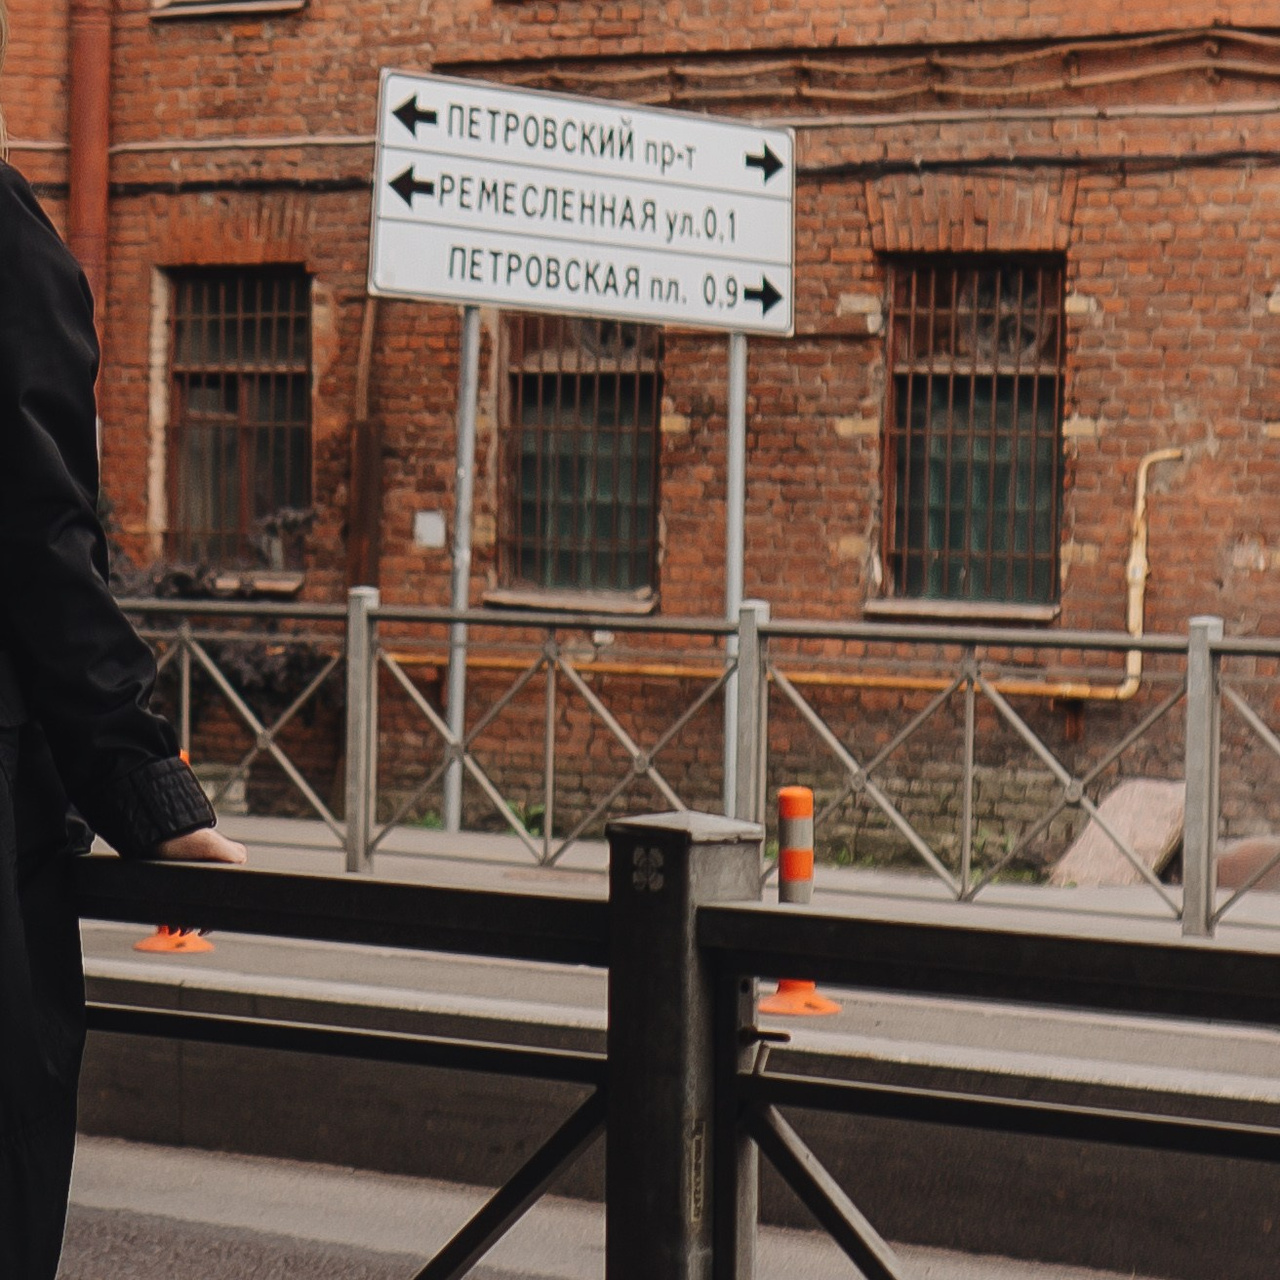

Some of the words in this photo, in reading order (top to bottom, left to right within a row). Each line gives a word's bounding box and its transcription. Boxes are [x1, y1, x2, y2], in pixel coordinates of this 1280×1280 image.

[448, 103, 634, 163] ПЕТРОВСКИЙ
[645, 140, 696, 175] пр-т
[439, 174, 656, 233] РЕМЕСЛЕННАЯ
[449, 246, 640, 299] ПЕТРОВСКАЯ
[650, 277, 687, 305] пл.
[703, 275, 738, 308] 0,9
